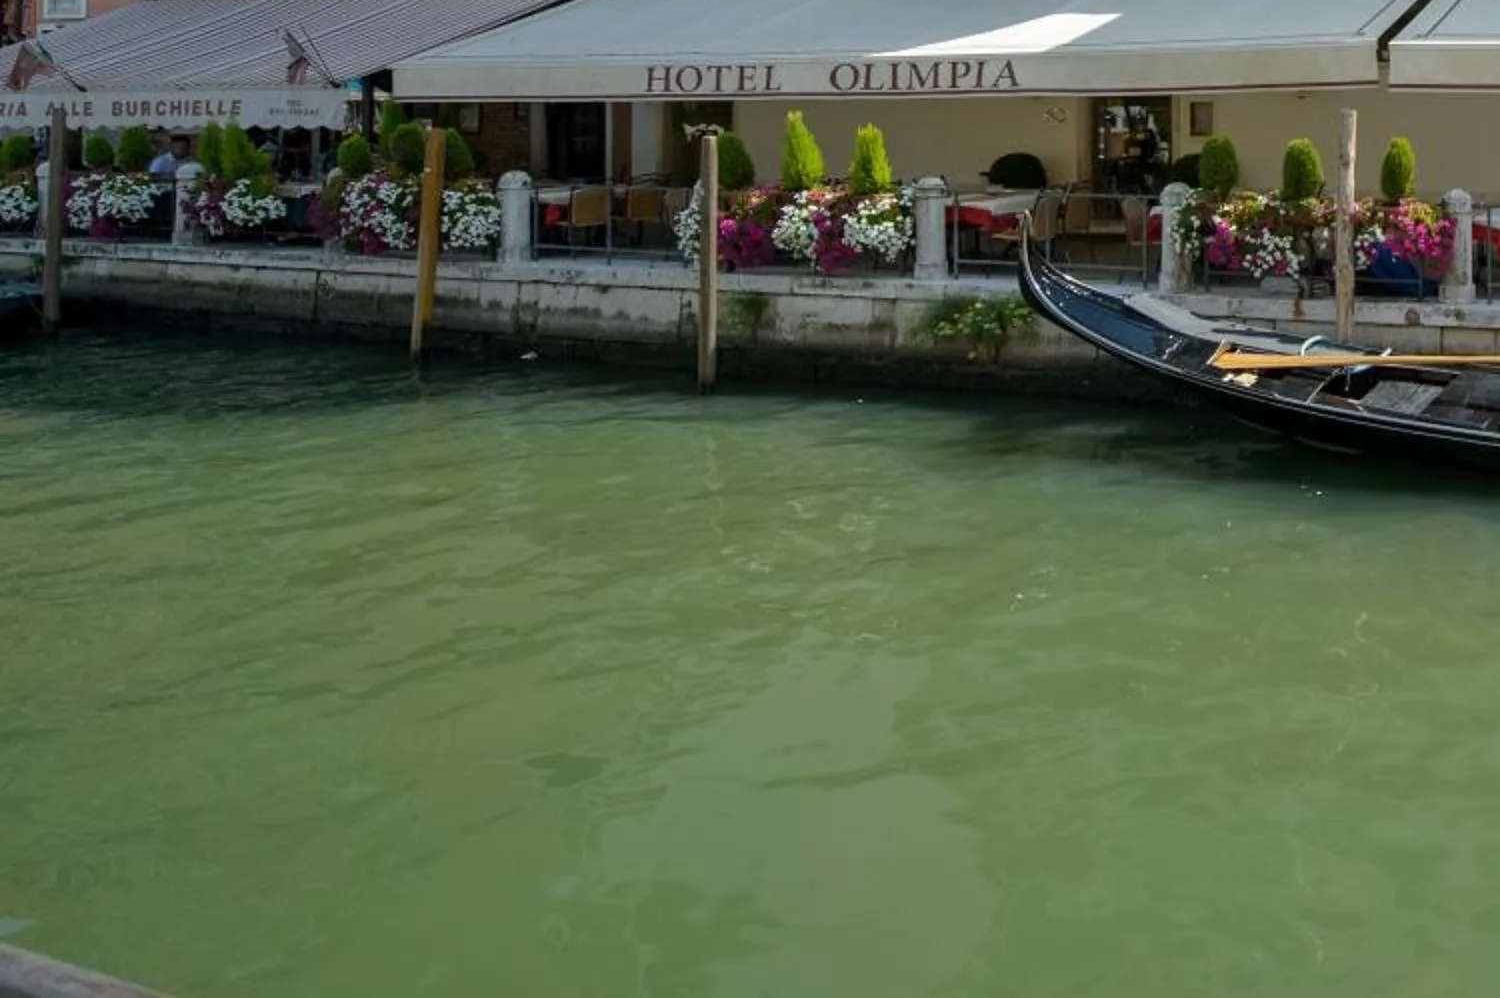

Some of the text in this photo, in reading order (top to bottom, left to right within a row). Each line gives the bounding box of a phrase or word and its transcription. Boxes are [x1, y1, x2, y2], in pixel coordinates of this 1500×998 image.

[645, 59, 1021, 93] HOTEL OLIMPIA
[111, 100, 243, 117] BURCHIELLE
